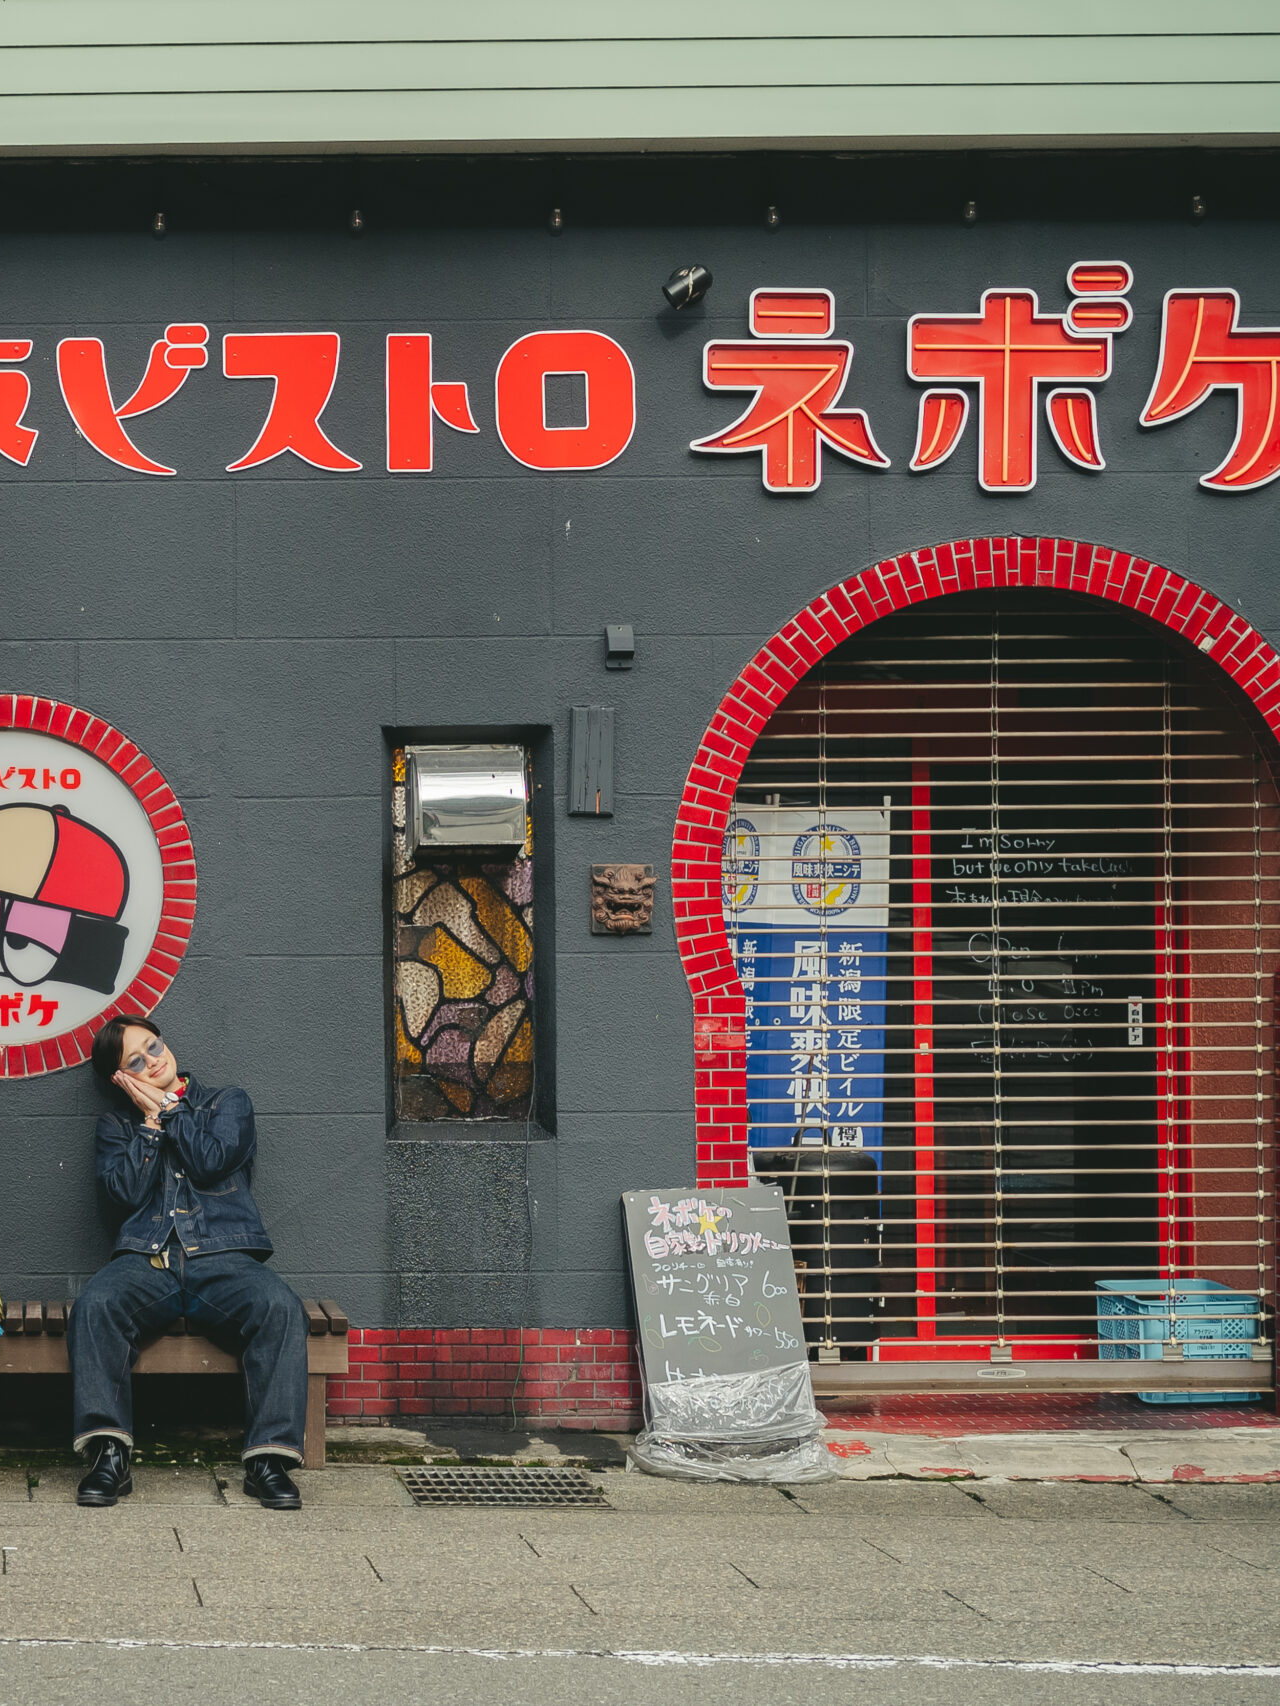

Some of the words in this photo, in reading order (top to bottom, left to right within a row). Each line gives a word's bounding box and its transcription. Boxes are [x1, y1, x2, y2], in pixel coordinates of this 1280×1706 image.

[688, 259, 1280, 493] ネボケ
[792, 862, 861, 878] 風味爽快ニシテ
[952, 858, 985, 876] but
[1057, 857, 1099, 873] take
[836, 942, 864, 1118] 新潟限定ビイル
[774, 1326, 800, 1349] 550
